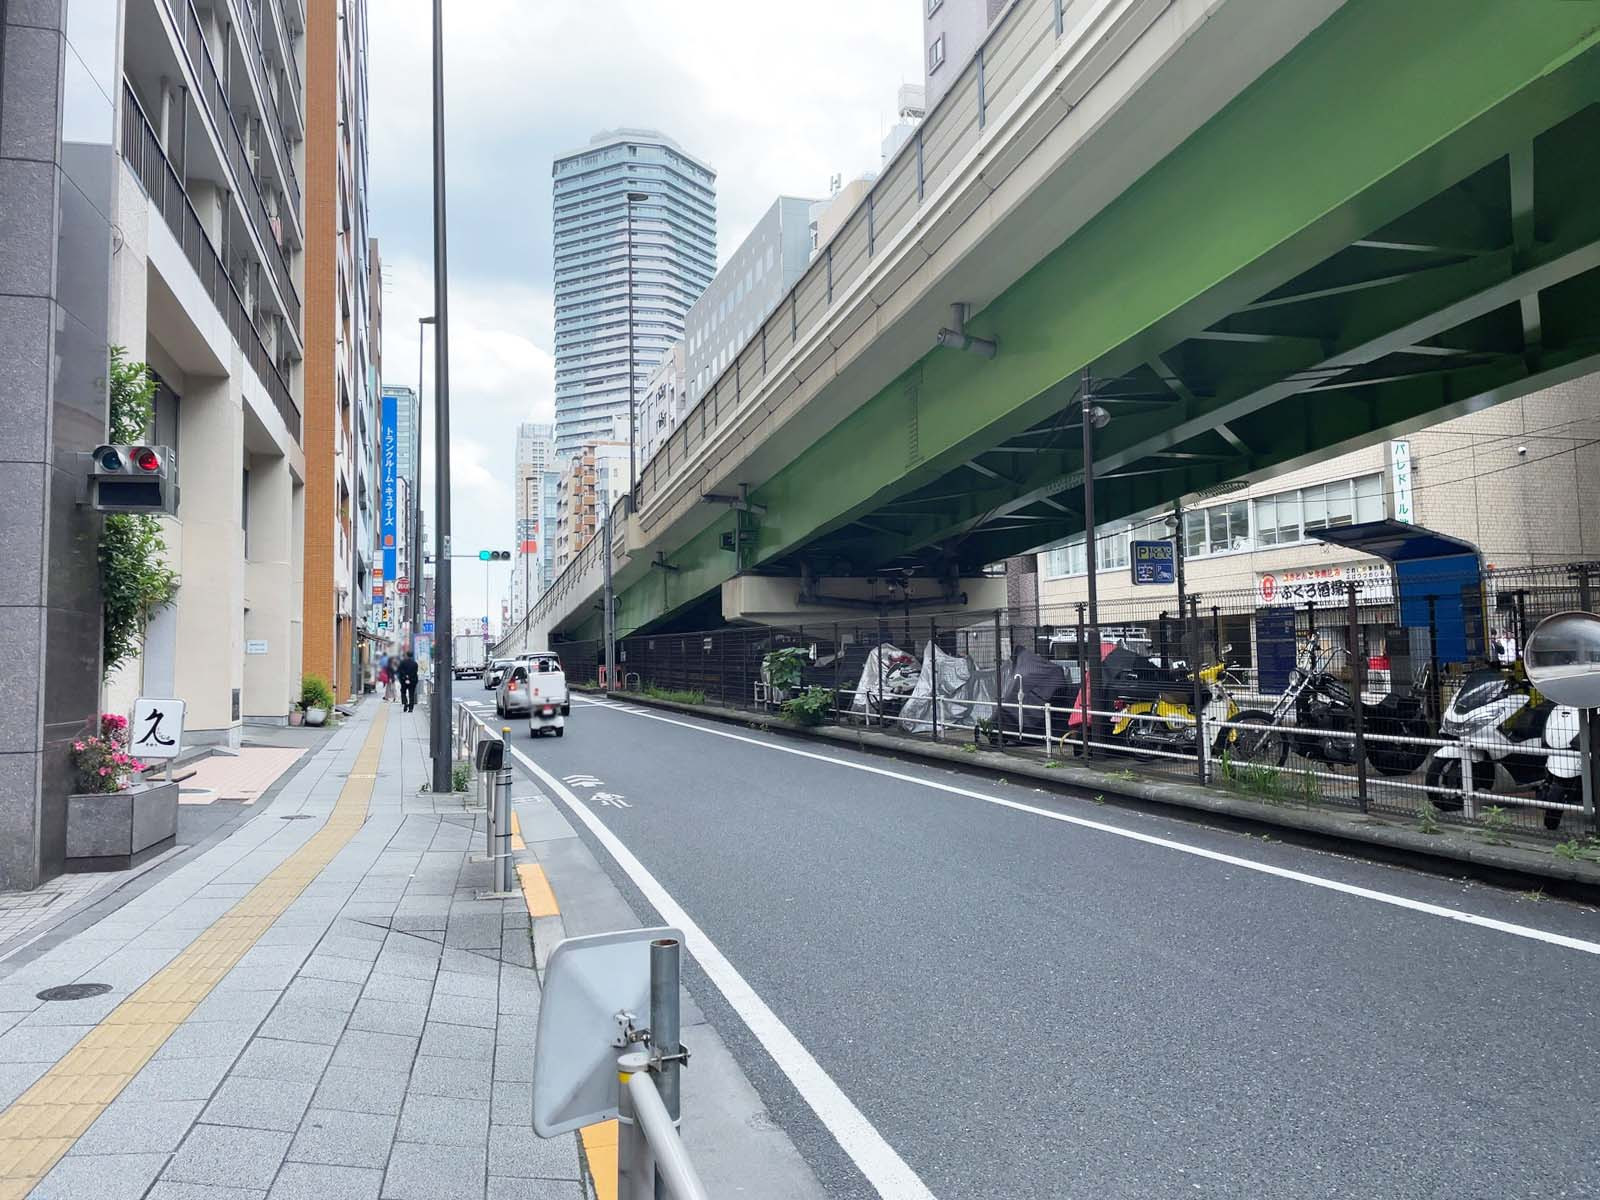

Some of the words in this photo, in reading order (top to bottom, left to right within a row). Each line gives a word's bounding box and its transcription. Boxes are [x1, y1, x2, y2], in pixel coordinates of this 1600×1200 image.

[385, 426, 395, 526] トランクルーム・キュラーズ
[135, 708, 175, 746] 久
